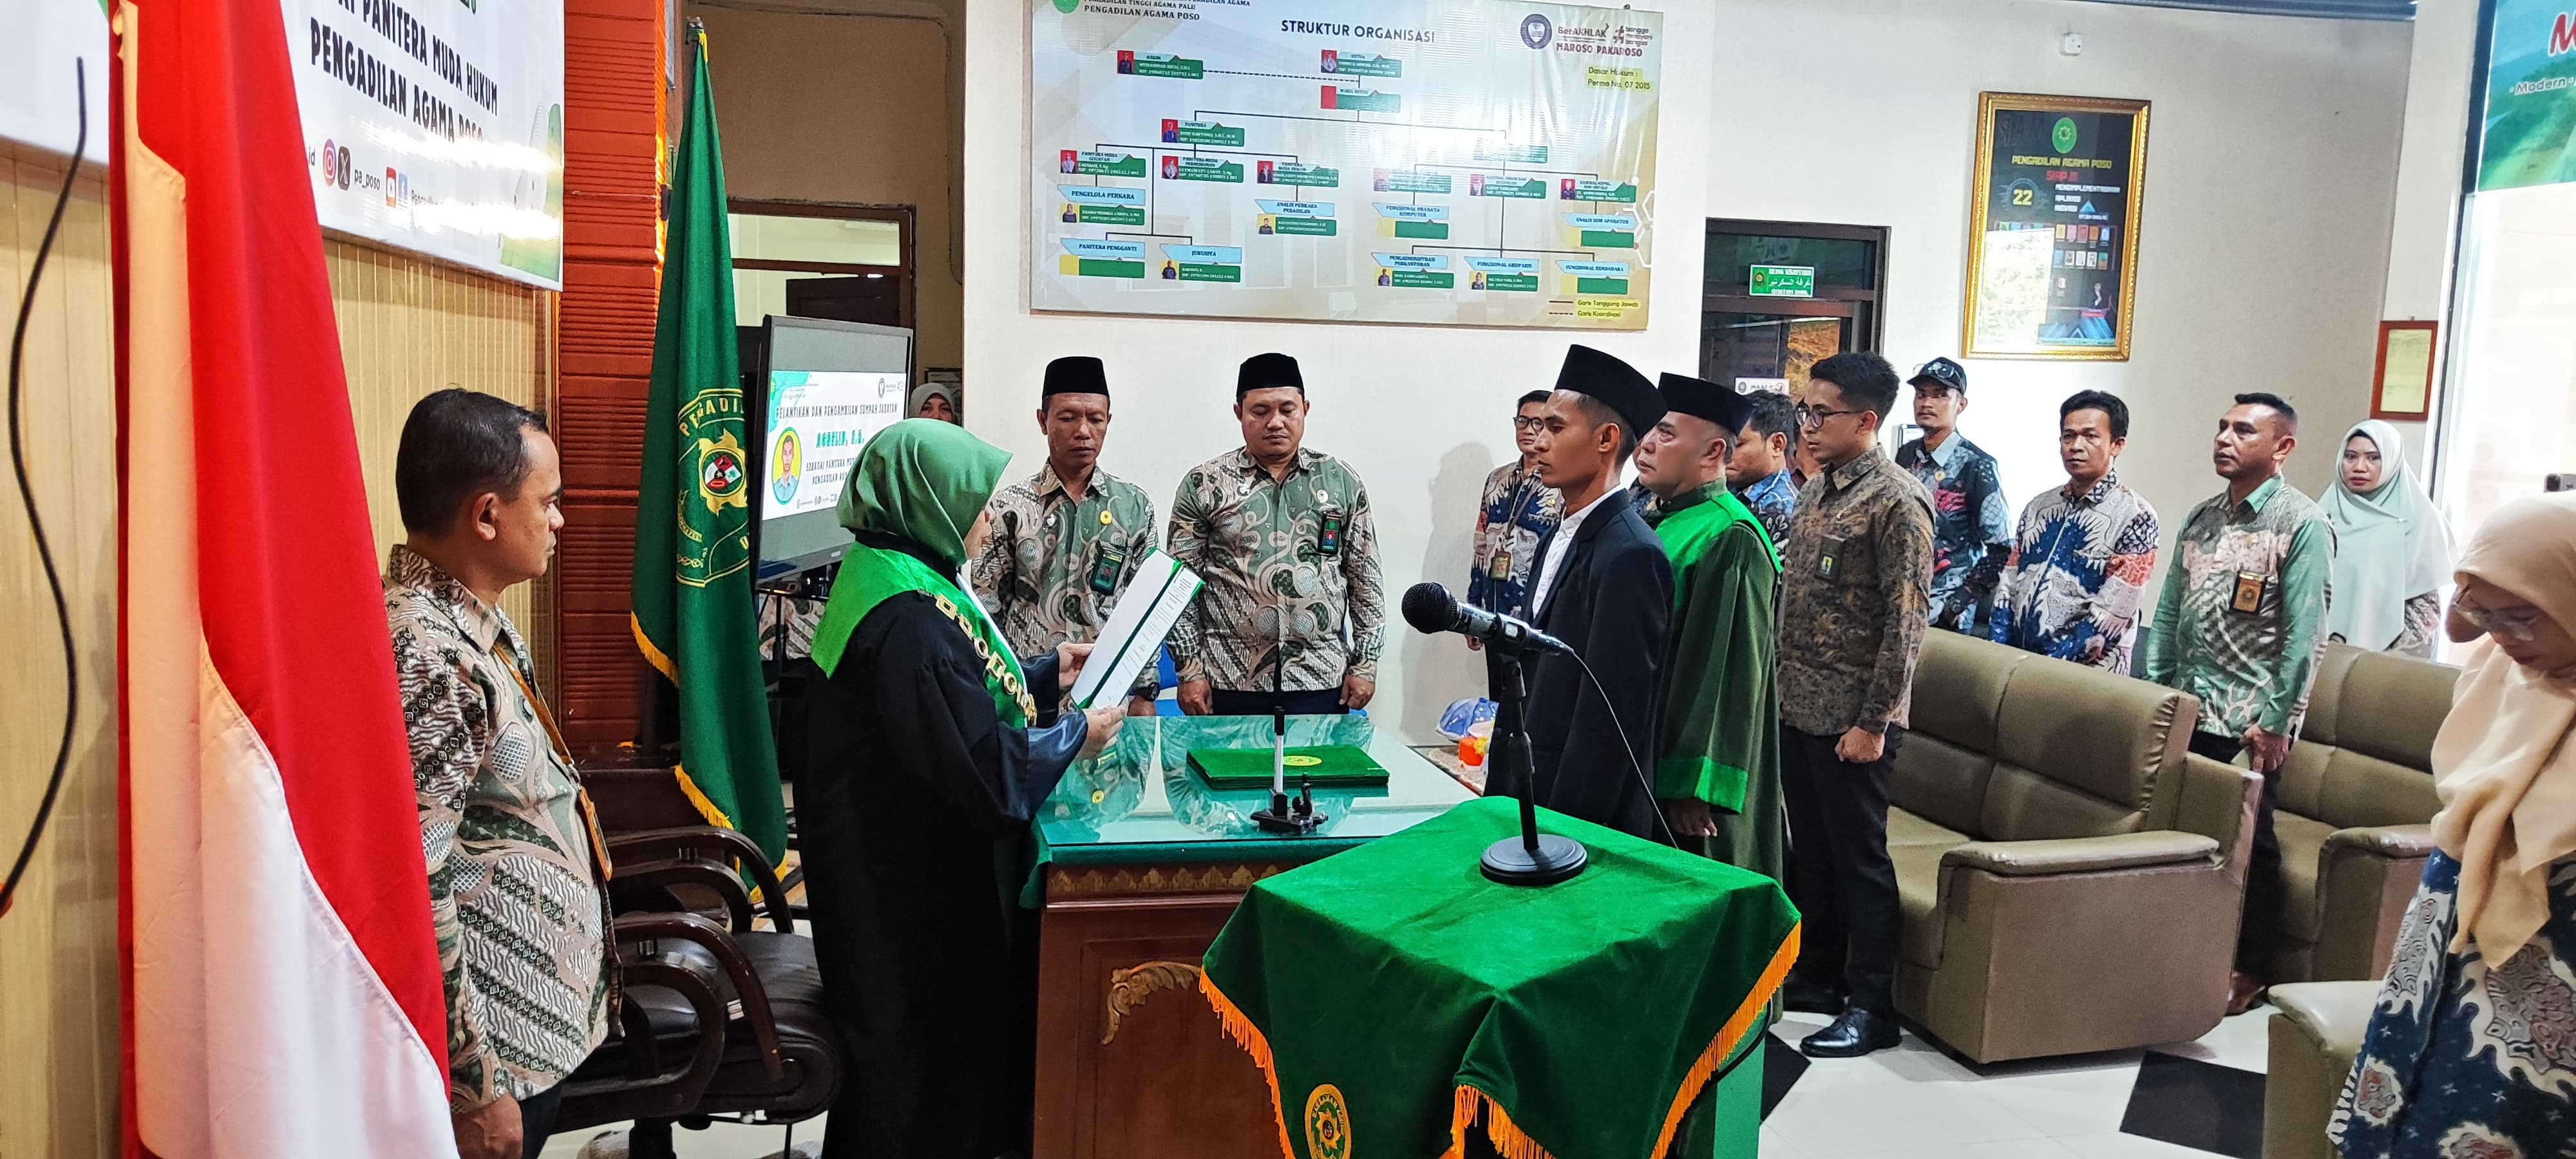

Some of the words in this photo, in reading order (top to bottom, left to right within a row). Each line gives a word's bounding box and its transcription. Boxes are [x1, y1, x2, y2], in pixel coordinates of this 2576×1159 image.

[1084, 5, 1141, 16] PENGADILAN
[1143, 10, 1175, 19] AGAMA
[1177, 12, 1200, 21] POSO
[1282, 20, 1350, 37] STRUKTUR
[1354, 26, 1435, 43] ORGANISASI
[1557, 42, 1593, 53] MAROSO
[1596, 45, 1643, 57] PAKAROSO
[363, 0, 428, 66] PANITERA
[433, 34, 462, 91] MUDA
[467, 61, 498, 116] HUKUM
[1588, 66, 1608, 75] Dasar
[1610, 68, 1634, 77] Hukum
[310, 17, 406, 117] PENGADILAN
[413, 84, 455, 144] AGAMA
[1587, 79, 1609, 88] Perma
[2514, 77, 2566, 95] Modern
[2012, 155, 2061, 166] PENGADILAN
[2062, 158, 2090, 167] AGAMA
[2091, 160, 2112, 169] POSO
[354, 168, 381, 191] pa_poso
[2045, 170, 2068, 182] SIAP
[2012, 189, 2034, 205] 22
[775, 405, 810, 419] PELANTIKAN
[811, 405, 822, 417] DAN
[824, 404, 858, 416] PENGAMBILAN
[860, 404, 878, 415] SUMPAH
